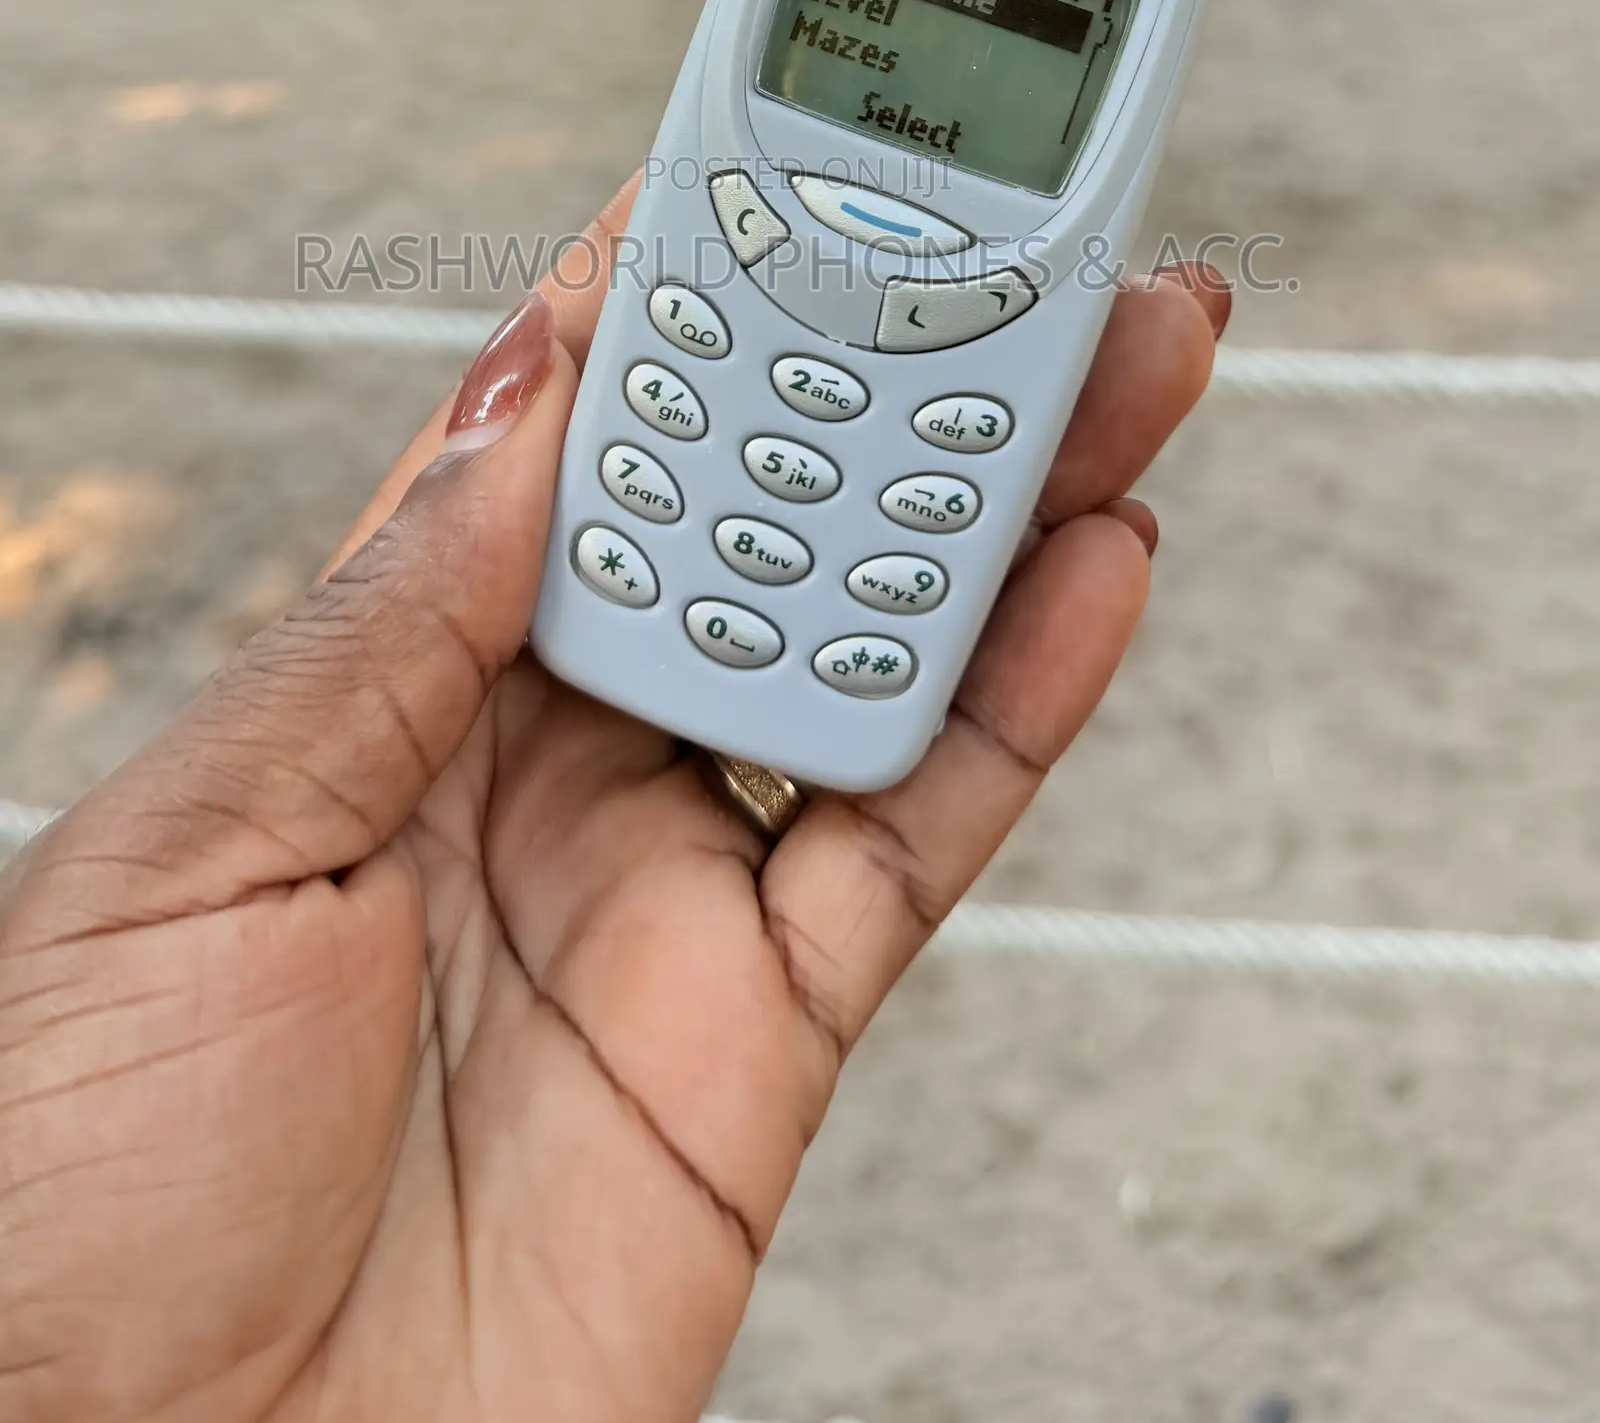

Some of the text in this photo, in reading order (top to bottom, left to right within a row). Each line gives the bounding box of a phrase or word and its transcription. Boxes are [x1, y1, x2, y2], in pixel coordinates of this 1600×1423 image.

[790, 10, 901, 74] Mazes
[857, 91, 963, 154] Select
[668, 298, 682, 321] 1
